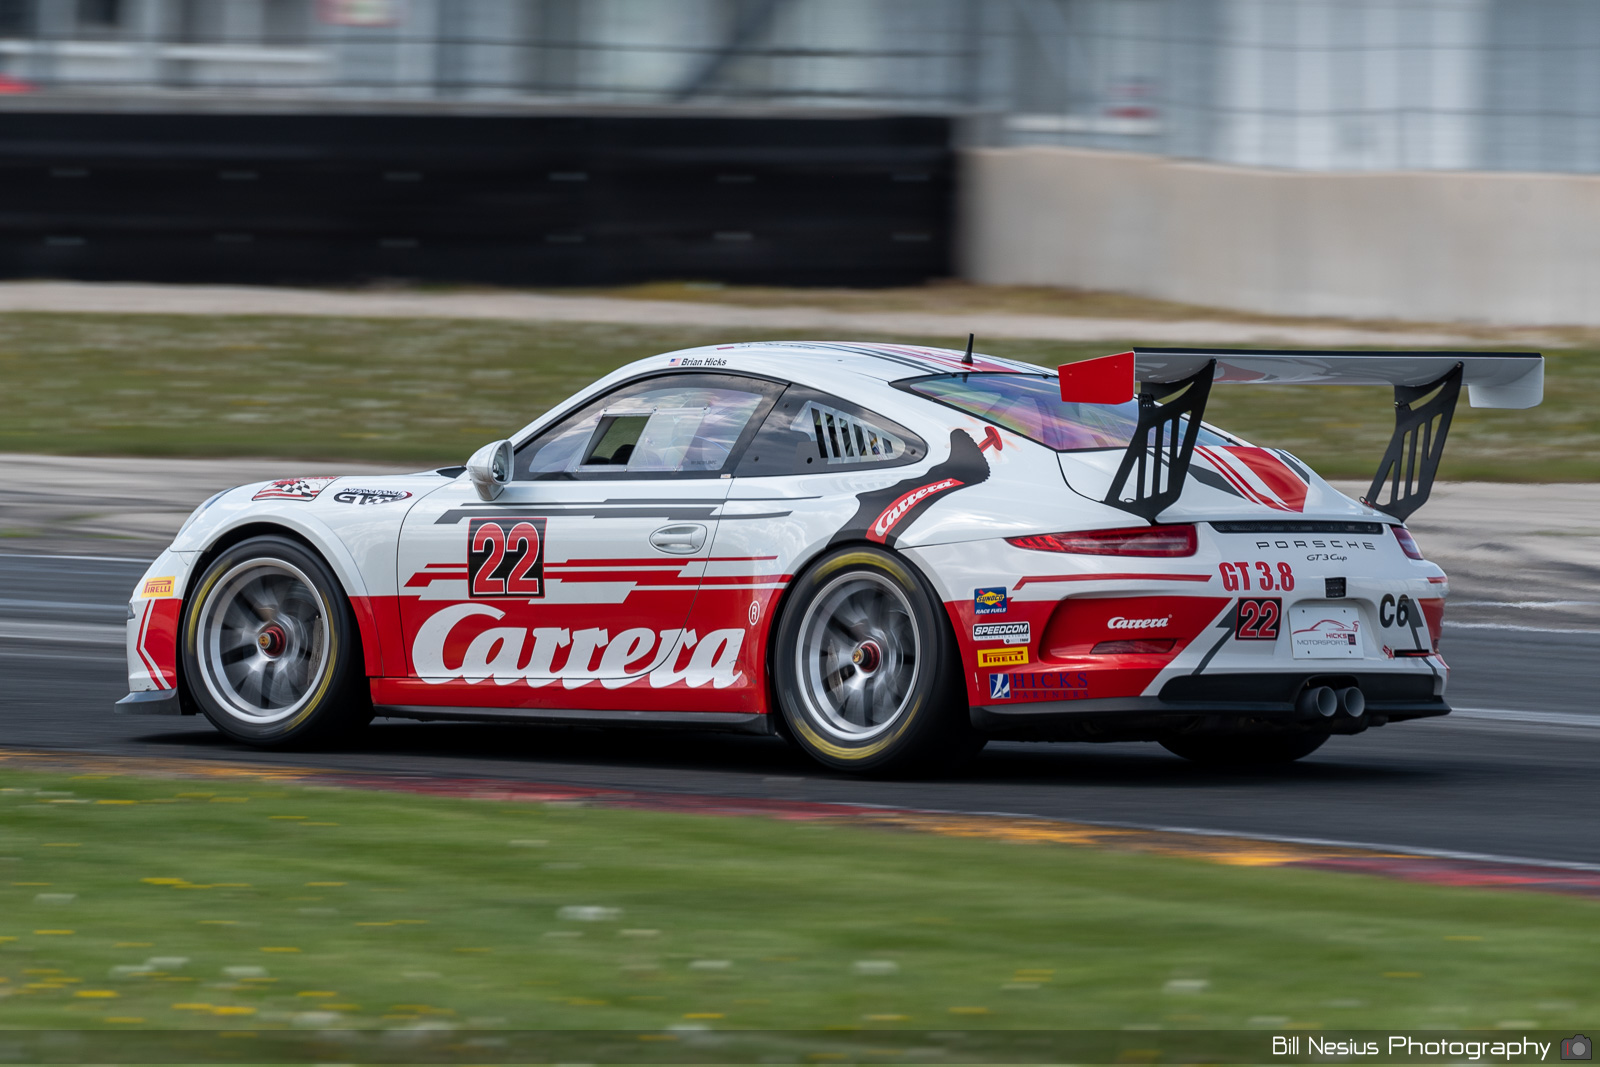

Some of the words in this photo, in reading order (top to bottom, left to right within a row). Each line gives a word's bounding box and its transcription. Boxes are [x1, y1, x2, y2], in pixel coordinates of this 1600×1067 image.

[681, 358, 702, 366] Brian
[704, 358, 727, 366] Hicks
[875, 479, 954, 537] Carrera
[1256, 540, 1376, 550] PORSCHE
[472, 522, 540, 595] 22
[1219, 562, 1251, 591] GT
[1255, 561, 1295, 591] 3.8
[144, 580, 171, 593] PIRELLI
[977, 594, 1005, 603] SUNOCO
[1379, 593, 1410, 628] C6
[1107, 616, 1169, 630] Carrera
[1238, 600, 1278, 638] 22
[974, 624, 1028, 635] SPEEDCOM
[412, 603, 747, 690] Carrera
[983, 650, 1024, 663] PIRELLI
[1013, 672, 1088, 688] HICKS
[1014, 690, 1089, 699] PARTNERS
